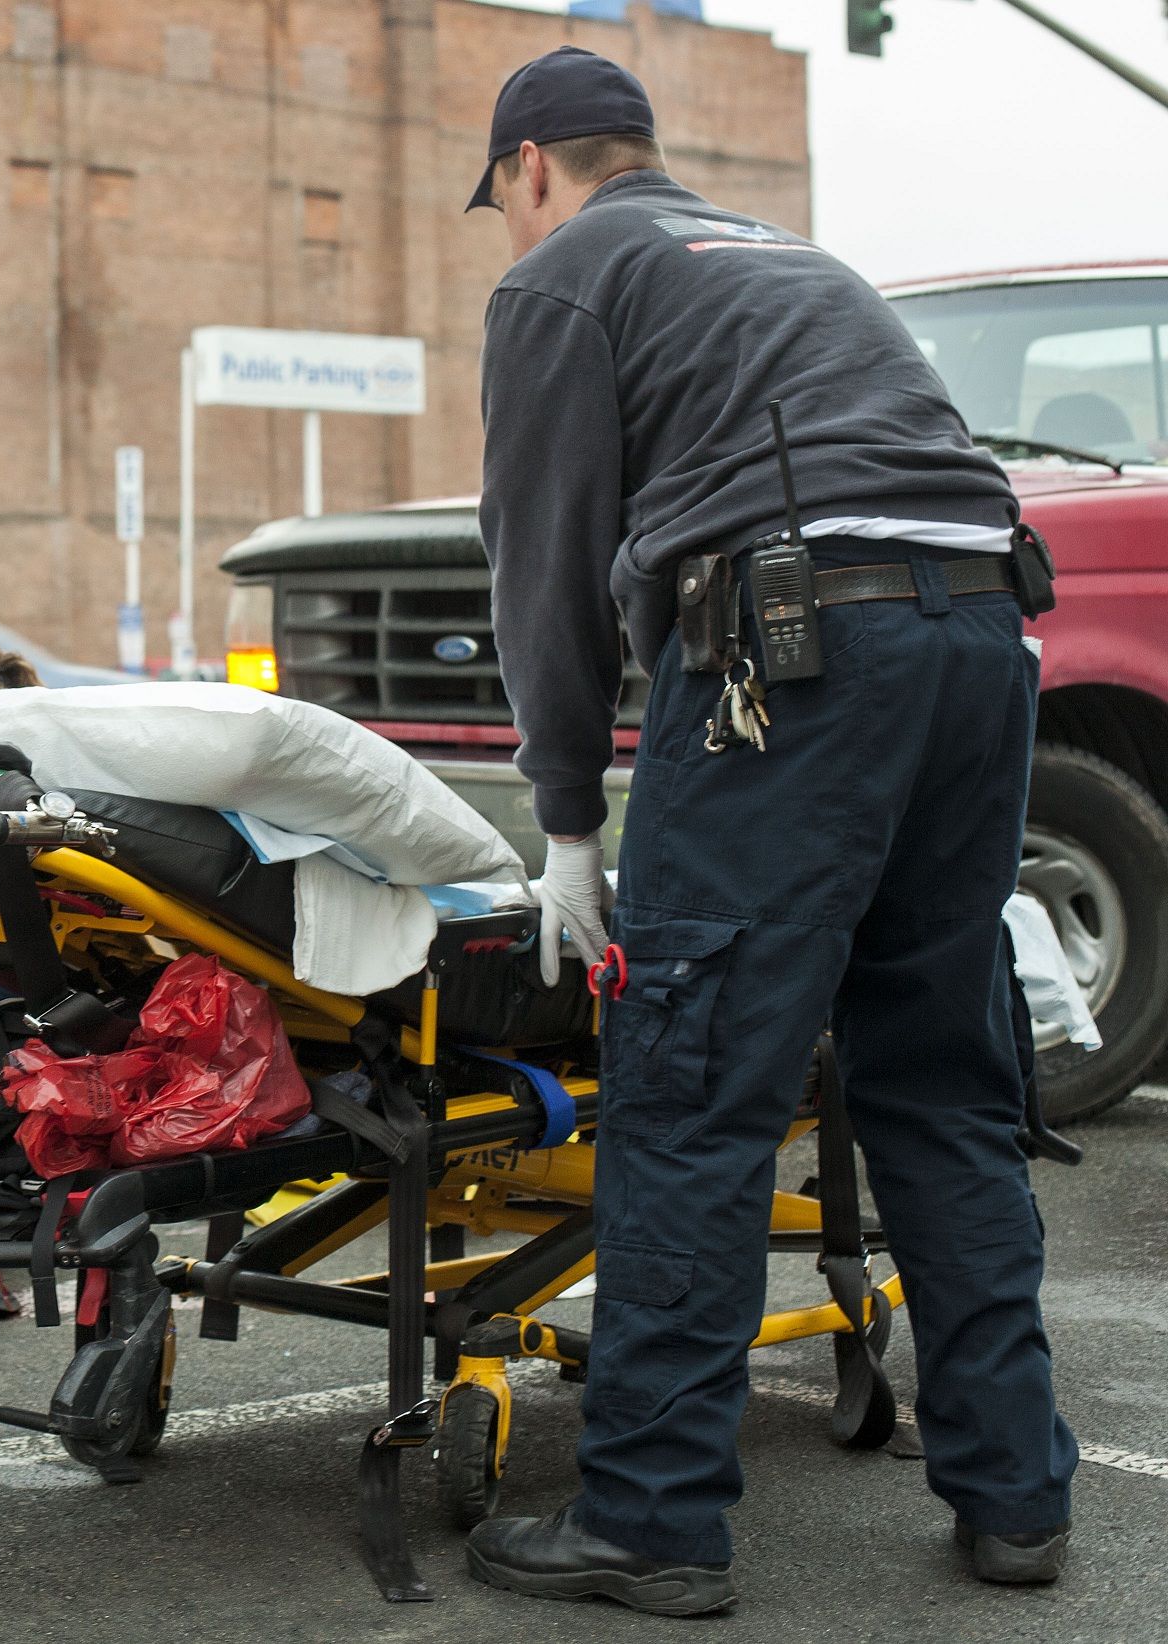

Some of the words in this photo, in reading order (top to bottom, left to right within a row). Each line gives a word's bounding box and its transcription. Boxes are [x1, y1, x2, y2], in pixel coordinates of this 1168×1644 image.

[221, 351, 282, 383] Public
[292, 356, 368, 392] Parking
[776, 643, 800, 665] 67
